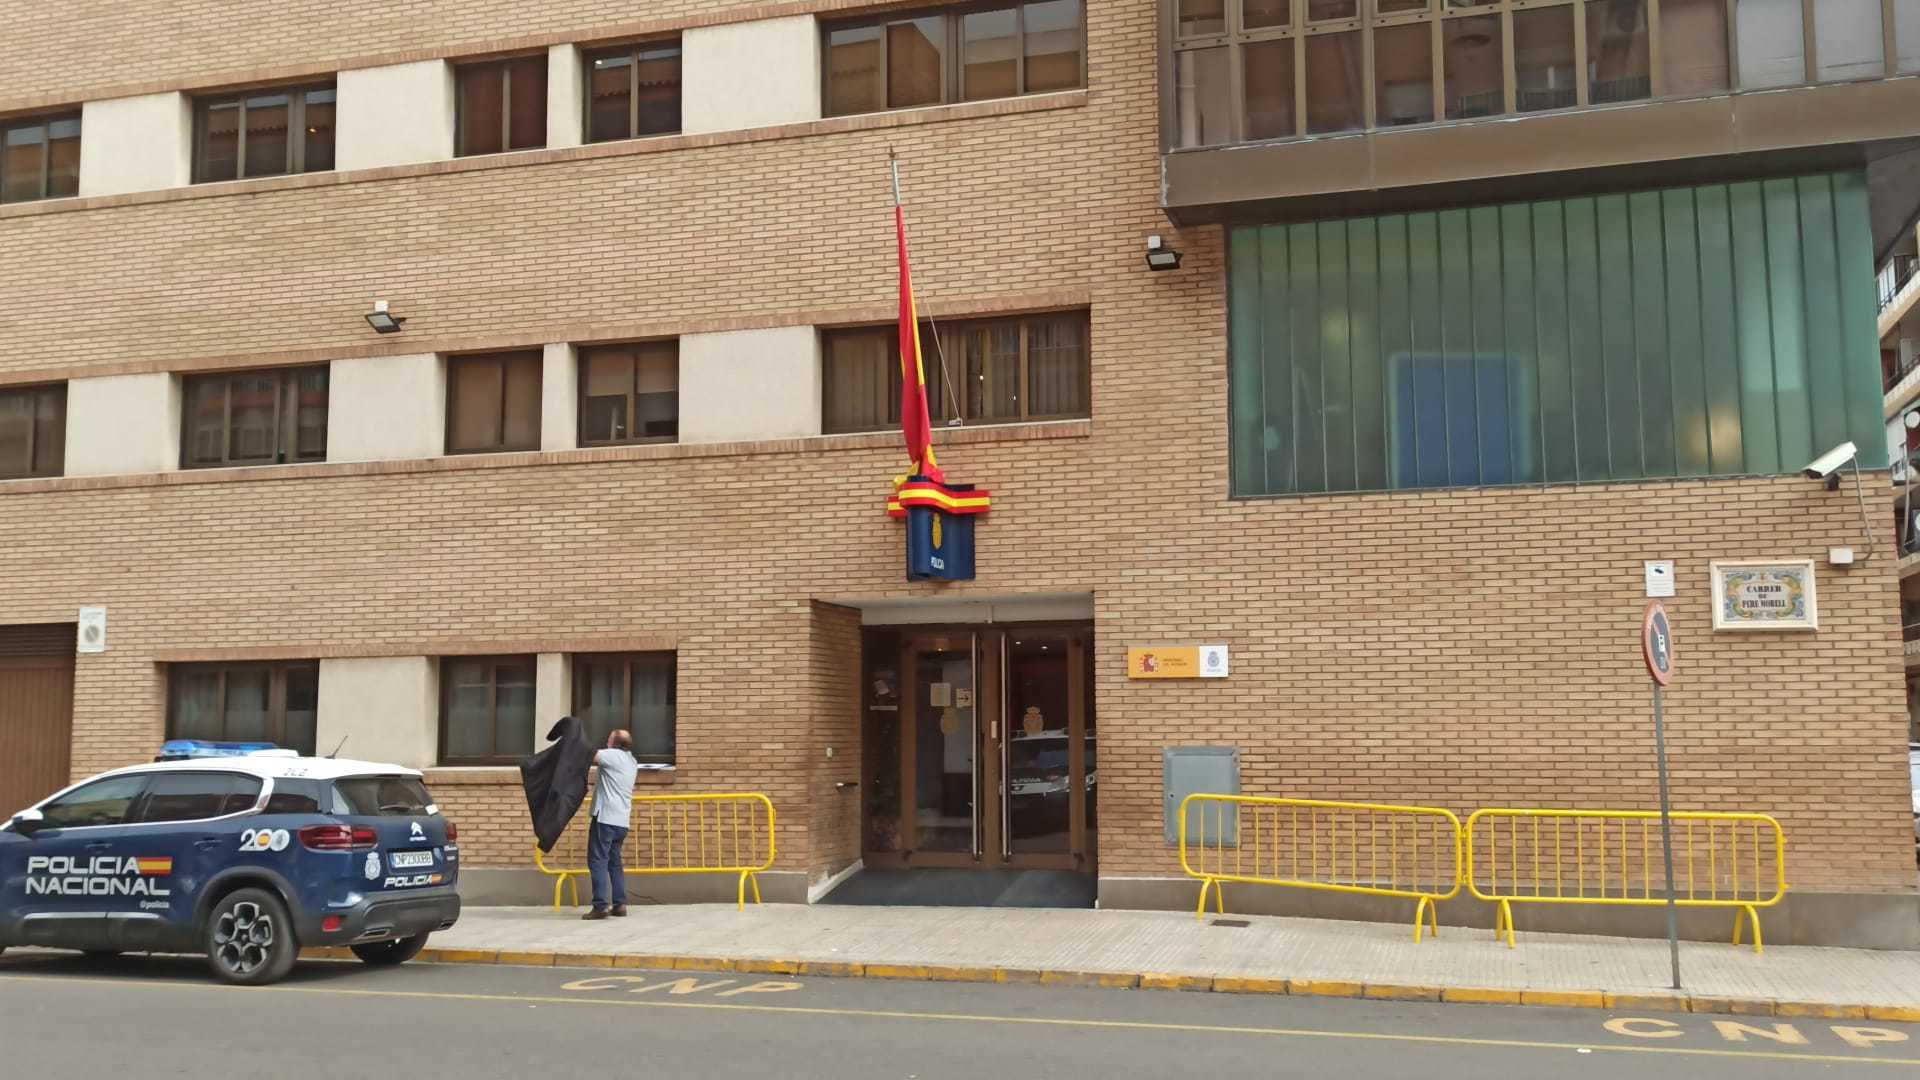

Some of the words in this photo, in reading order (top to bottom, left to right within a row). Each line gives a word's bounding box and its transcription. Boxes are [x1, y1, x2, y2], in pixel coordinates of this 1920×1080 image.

[1746, 585, 1782, 593] CARRER
[1742, 600, 1759, 608] PERE
[1761, 599, 1786, 608] MORELL
[239, 828, 291, 852] 200
[27, 856, 140, 875] POLICIA
[25, 876, 171, 896] NACIONAL
[384, 875, 432, 888] POLICIA
[560, 976, 804, 996] CNP
